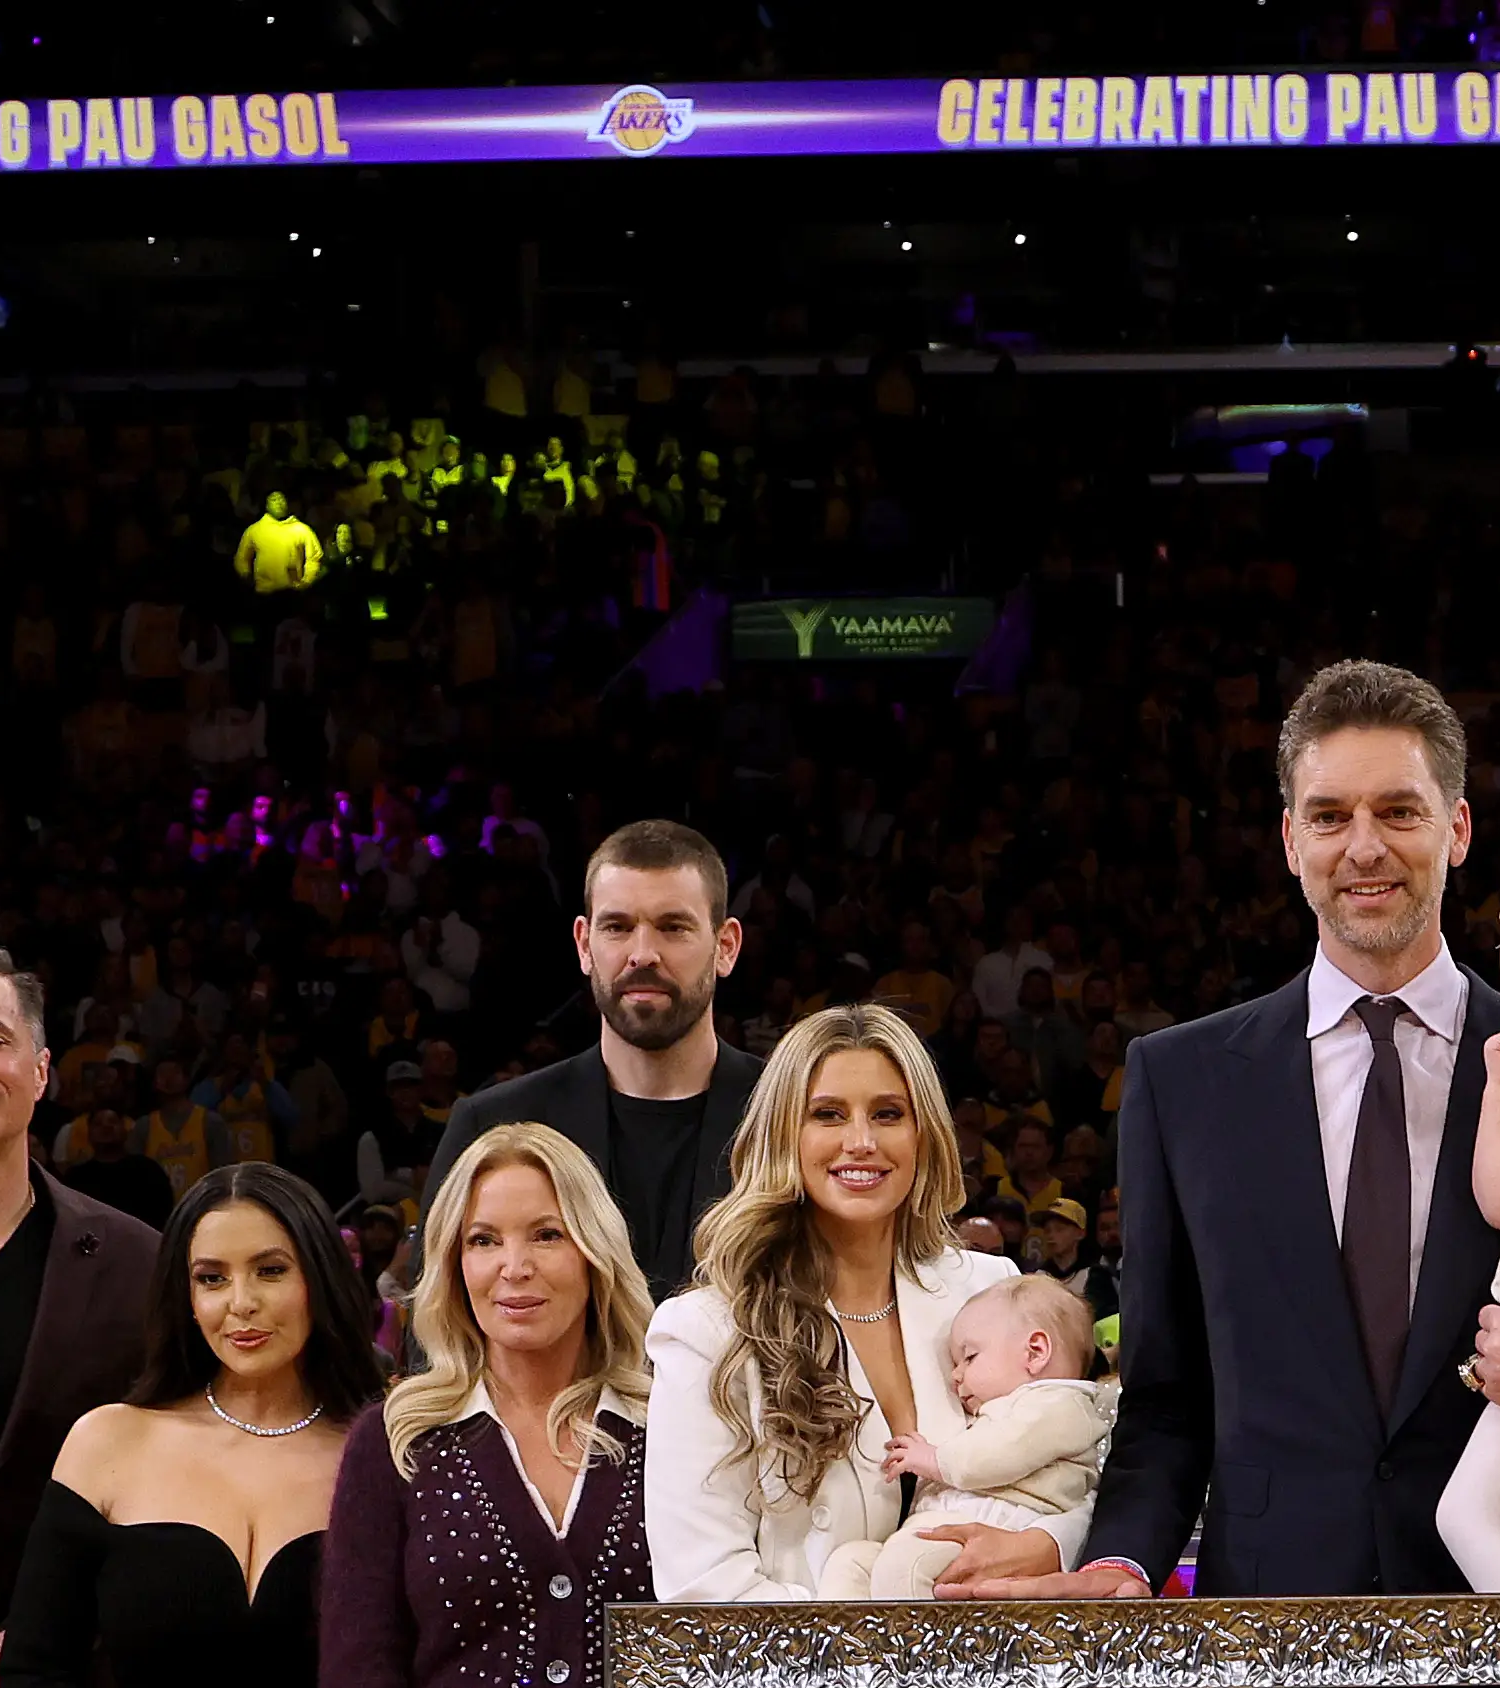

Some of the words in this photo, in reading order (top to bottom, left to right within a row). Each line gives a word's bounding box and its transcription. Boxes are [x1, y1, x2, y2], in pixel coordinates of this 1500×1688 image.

[48, 95, 156, 163] PAU
[172, 91, 350, 160] GASOL
[598, 103, 685, 137] LAKERS
[937, 72, 1308, 144] CELEBRATING
[1328, 71, 1439, 139] PAU
